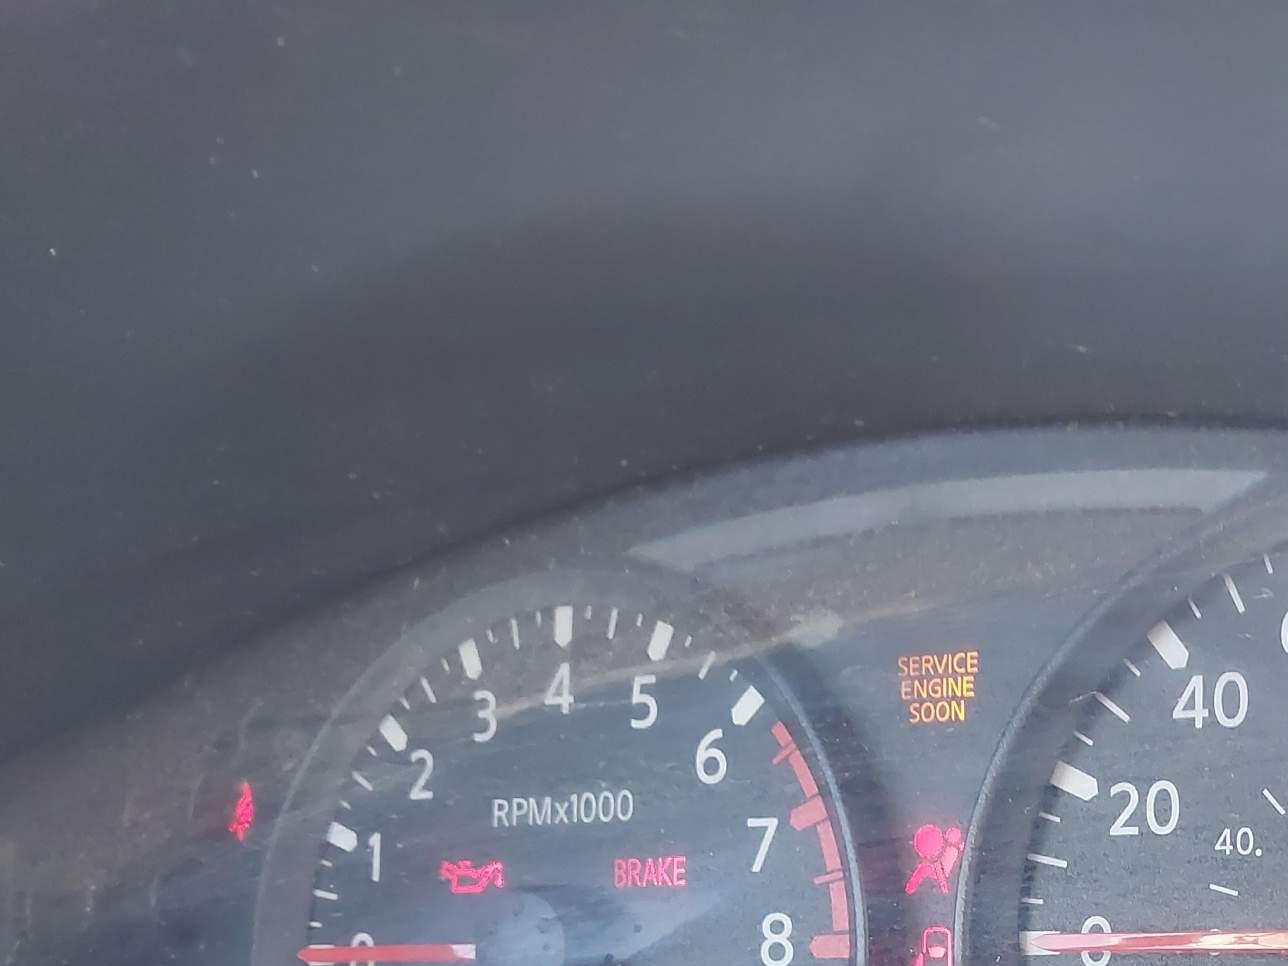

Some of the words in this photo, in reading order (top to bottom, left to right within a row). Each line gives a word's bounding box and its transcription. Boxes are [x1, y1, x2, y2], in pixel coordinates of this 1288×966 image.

[544, 662, 575, 713] 4
[898, 650, 980, 678] SERVICE
[901, 676, 976, 700] ENGINE
[472, 690, 499, 742] 3
[631, 675, 658, 728] 5
[909, 700, 966, 725] SOON
[1172, 671, 1249, 729] 40
[409, 750, 434, 801] 2
[695, 729, 728, 785] 6
[492, 789, 635, 827] RPMx1000
[1108, 780, 1181, 837] 20
[369, 832, 382, 882] 1
[747, 817, 779, 874] 7
[1213, 828, 1256, 858] 40
[614, 857, 686, 888] BRAKE
